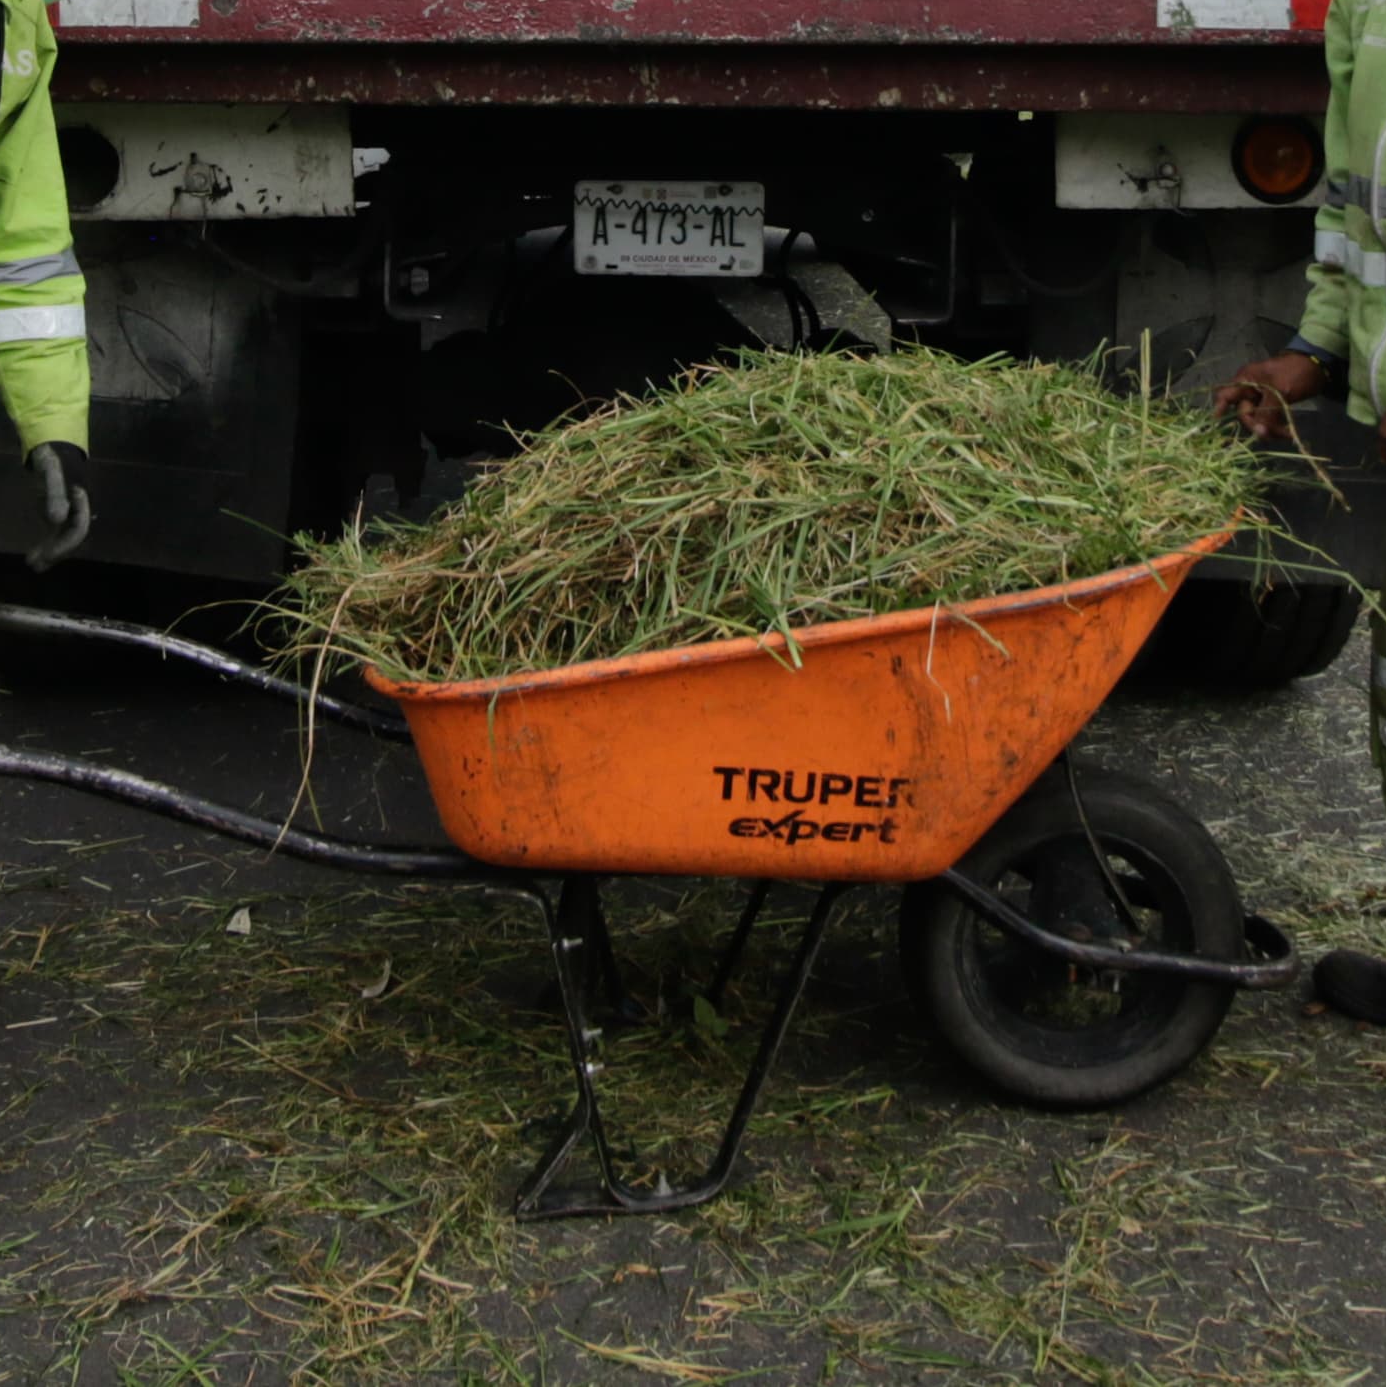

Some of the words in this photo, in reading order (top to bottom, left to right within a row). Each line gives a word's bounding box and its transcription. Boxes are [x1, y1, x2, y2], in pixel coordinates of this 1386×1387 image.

[591, 205, 746, 248] A-473-AL
[632, 254, 666, 264] CIUDAD
[668, 254, 680, 264] DE
[713, 765, 916, 809] TRUPER
[728, 809, 900, 846] expert
